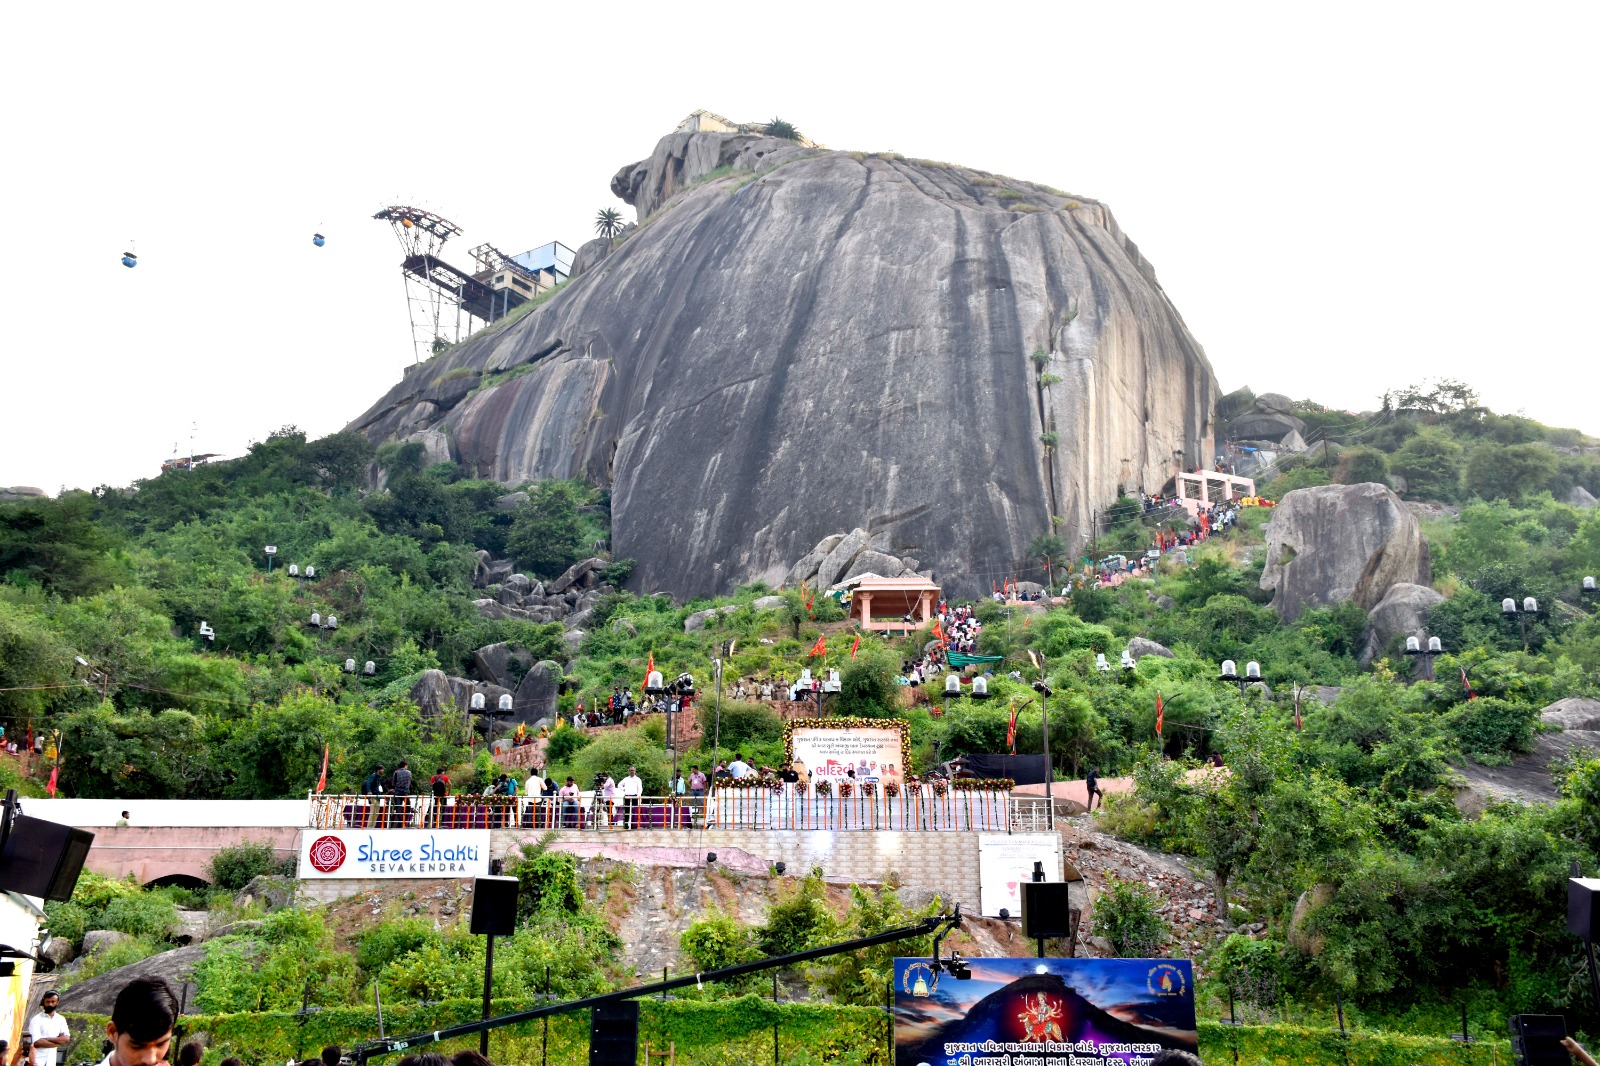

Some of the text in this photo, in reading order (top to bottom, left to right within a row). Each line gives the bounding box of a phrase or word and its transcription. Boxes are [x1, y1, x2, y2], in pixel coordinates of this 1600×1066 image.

[357, 835, 479, 862] Shree Shakti
[944, 1039, 1162, 1055] ગુજરાત પવિત્ર યાત્રાધામ વિકાસ બોર્ડ, ગુજરાત સરકાર
[958, 1054, 971, 1066] શ્રી
[1046, 1057, 1067, 1066] માતા
[1130, 1055, 1155, 1066] અંબા
